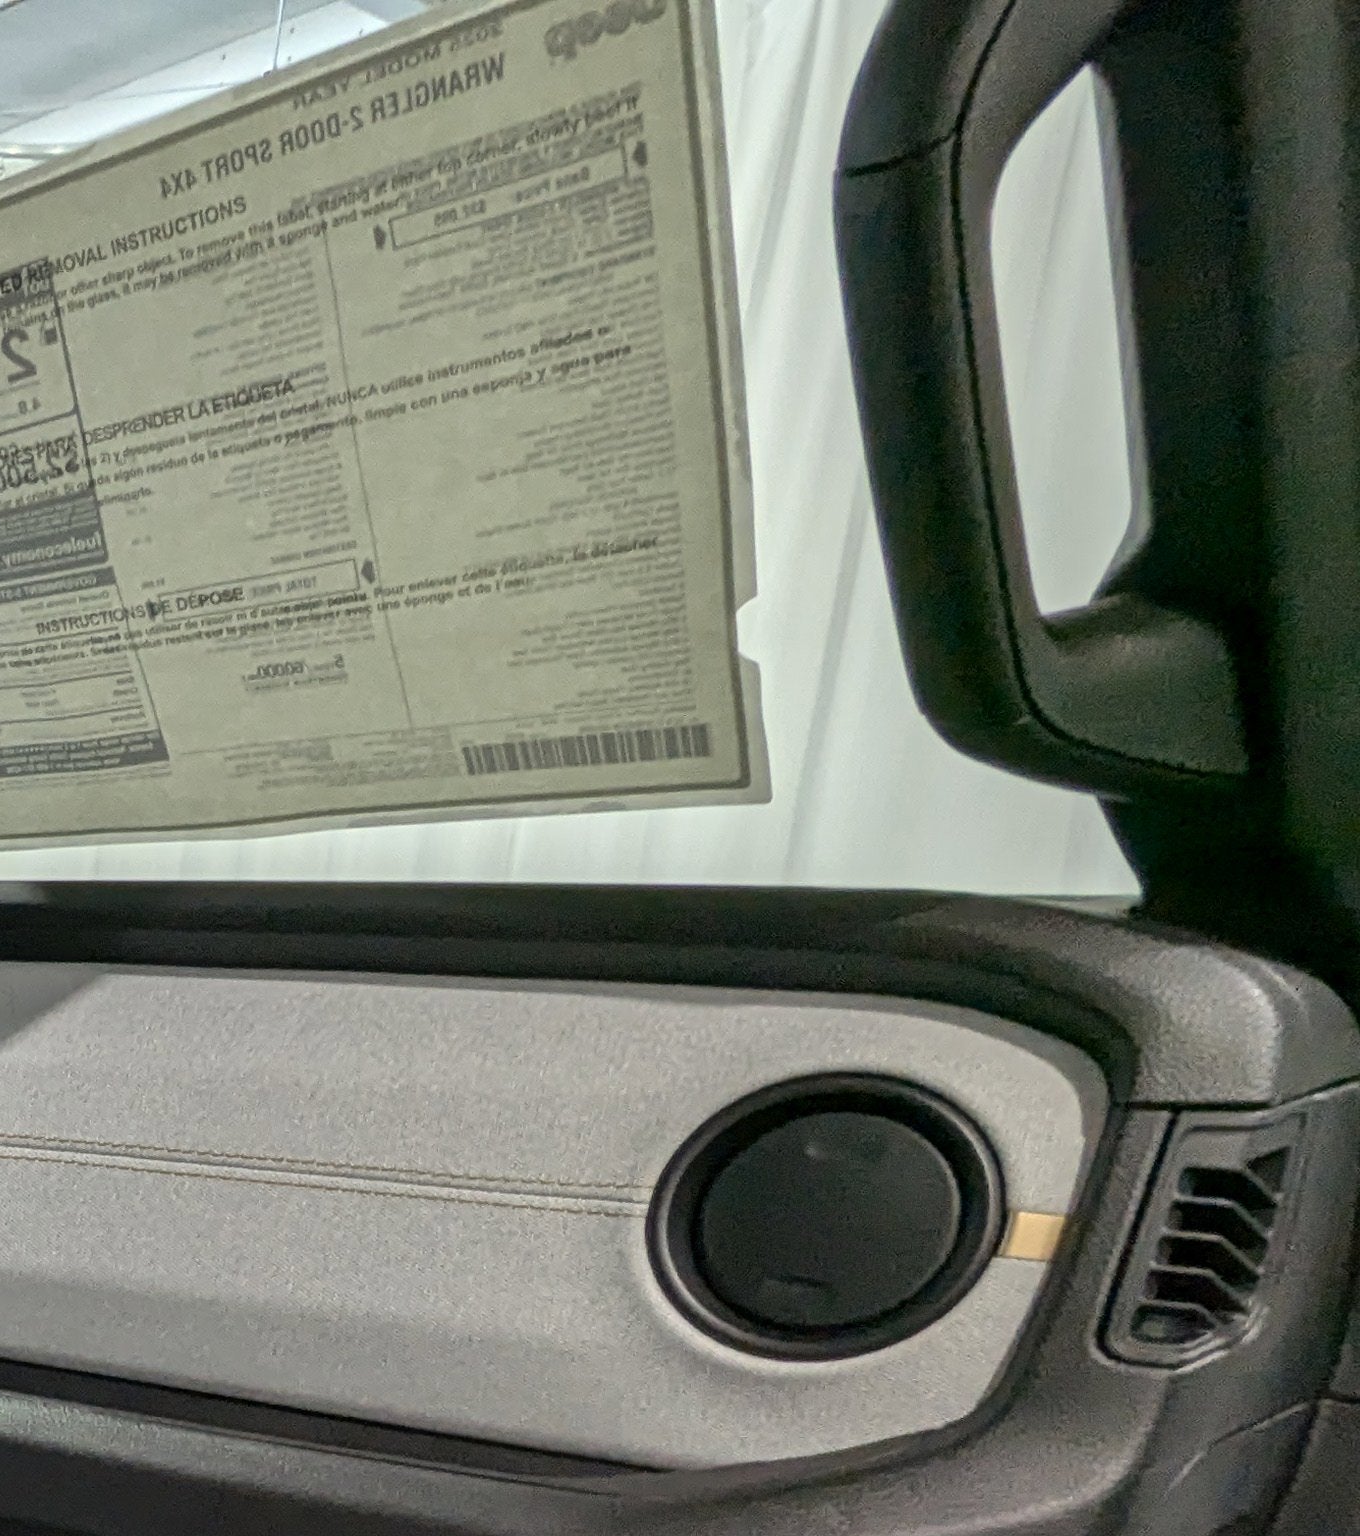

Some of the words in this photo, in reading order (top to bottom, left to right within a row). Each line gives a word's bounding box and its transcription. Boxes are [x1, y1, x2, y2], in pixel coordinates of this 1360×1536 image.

[110, 196, 247, 258] INSTRUCTIONS
[82, 407, 186, 446] DESPRENDER
[188, 398, 211, 420] LA
[213, 378, 295, 415] ETIQUETA
[35, 604, 146, 635] INSTRUCTIONS
